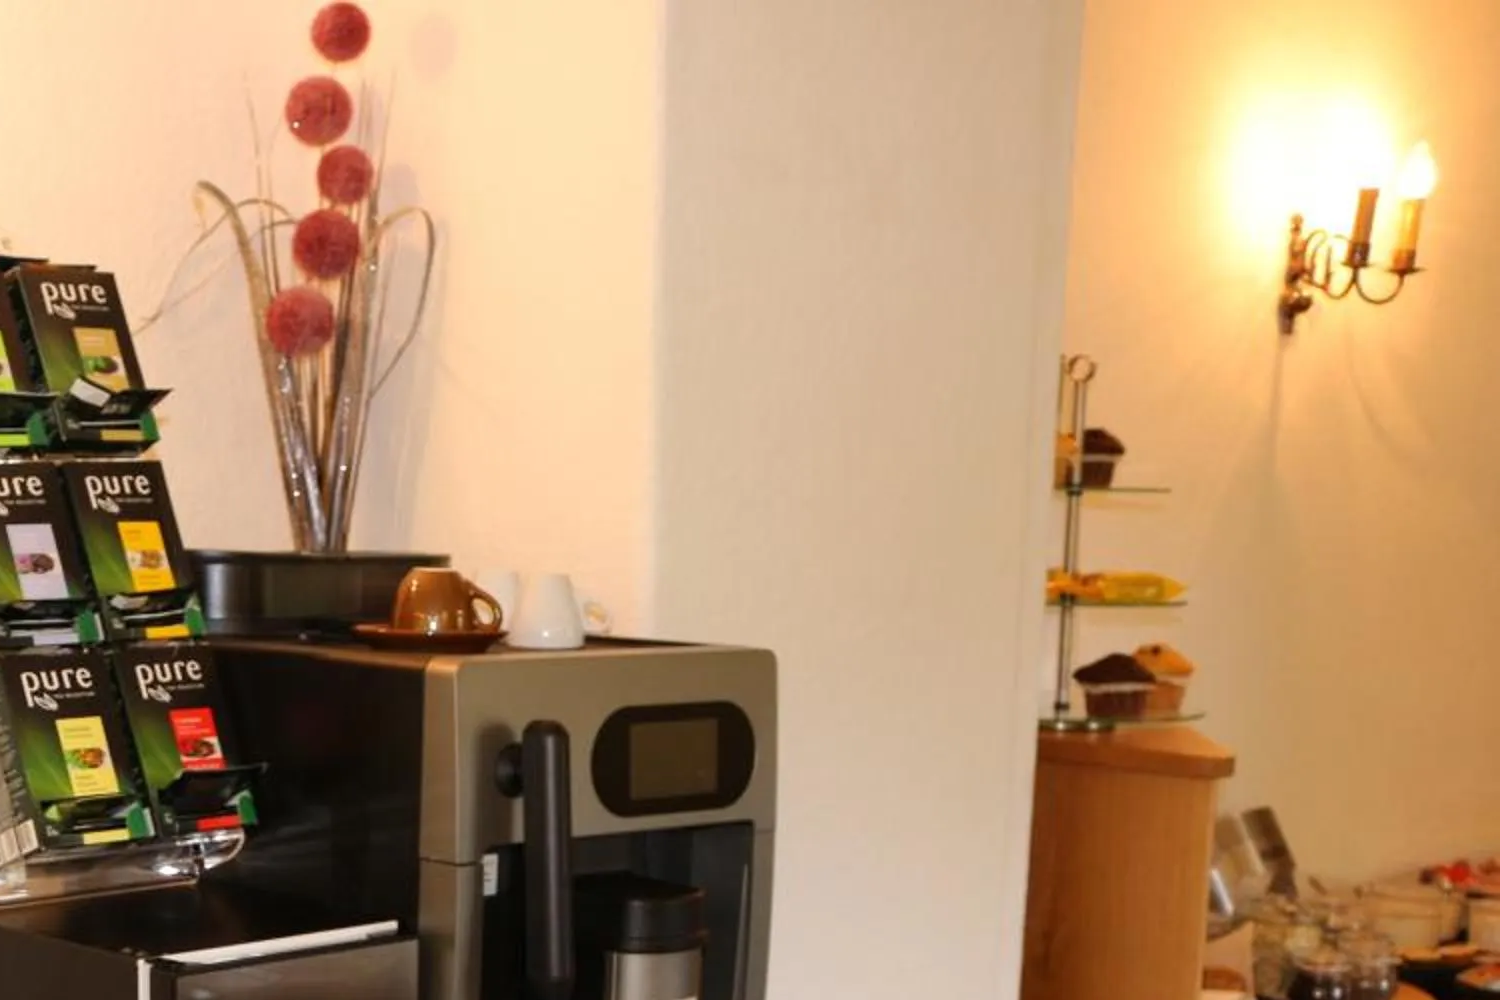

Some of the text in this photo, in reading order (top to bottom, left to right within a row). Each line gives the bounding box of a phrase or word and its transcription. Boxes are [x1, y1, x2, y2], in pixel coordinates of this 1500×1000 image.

[41, 282, 107, 315] pure
[84, 474, 151, 510] pure
[20, 667, 94, 708] pure
[134, 659, 203, 700] pure
